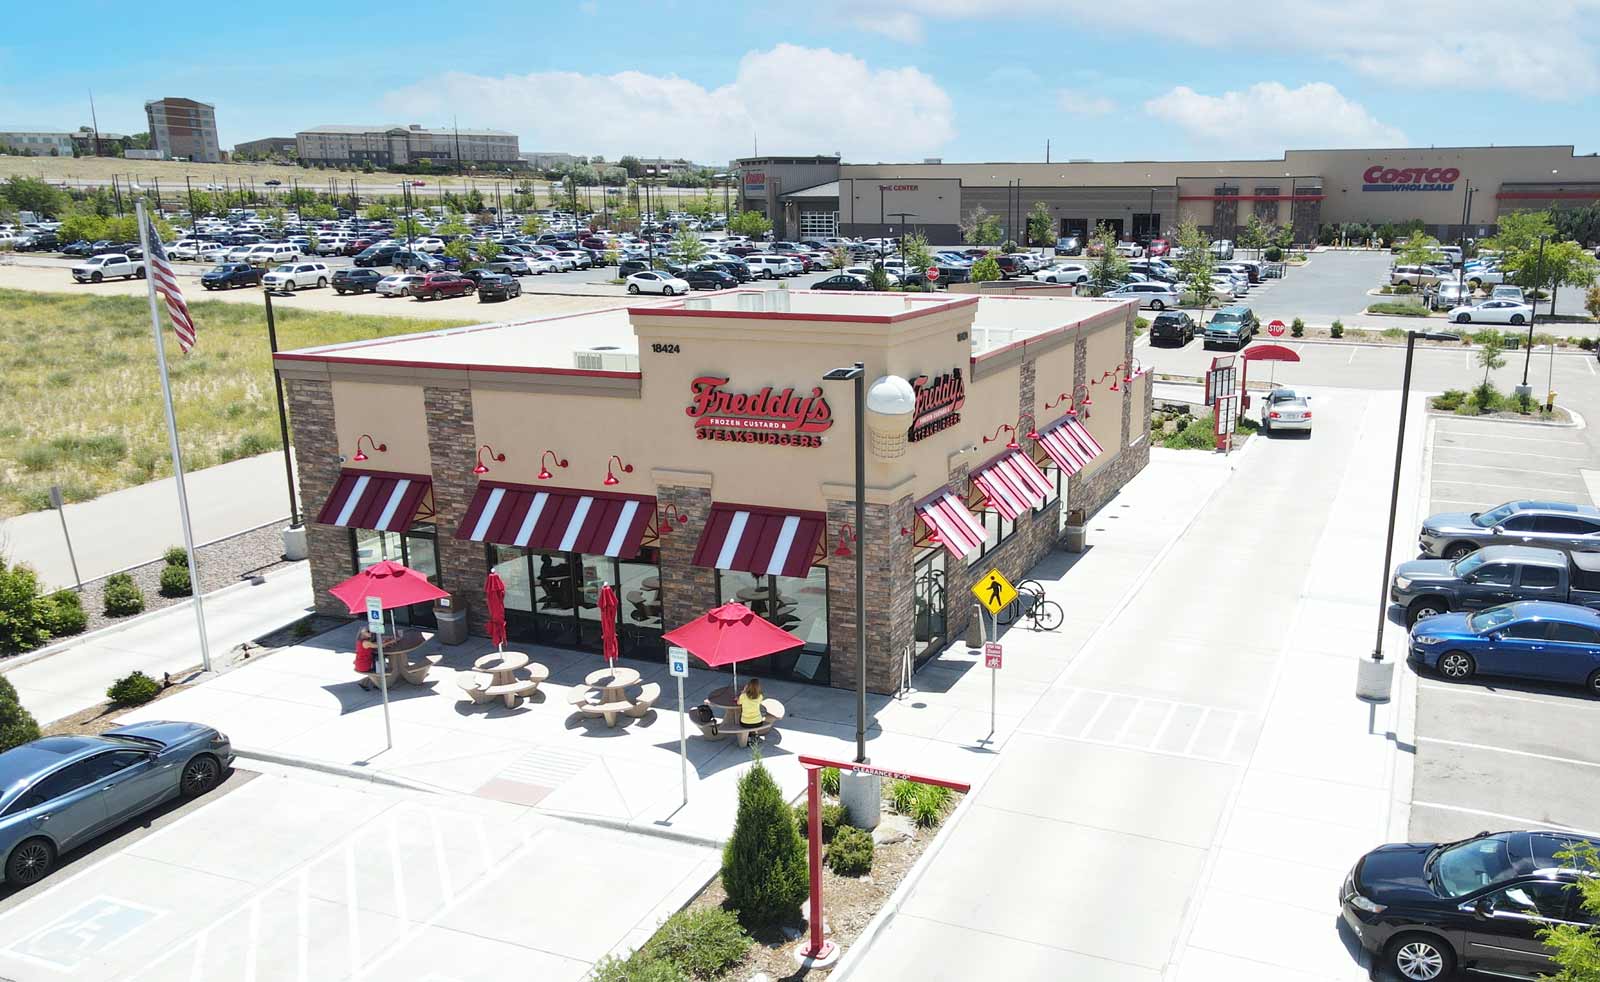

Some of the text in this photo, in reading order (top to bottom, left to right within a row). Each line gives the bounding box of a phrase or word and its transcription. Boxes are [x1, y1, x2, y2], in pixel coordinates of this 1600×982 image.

[1363, 165, 1460, 184] COSTCO
[893, 184, 919, 192] CENTER
[1391, 184, 1455, 192] WHOLESALE
[1268, 324, 1285, 333] STOP
[651, 343, 680, 354] 18424
[686, 376, 832, 430] Freddy's
[710, 418, 741, 427] FROZEN
[743, 421, 779, 429] CUSTARD
[696, 428, 822, 449] STEAKBURGERS
[852, 765, 892, 778] CLEARANCE
